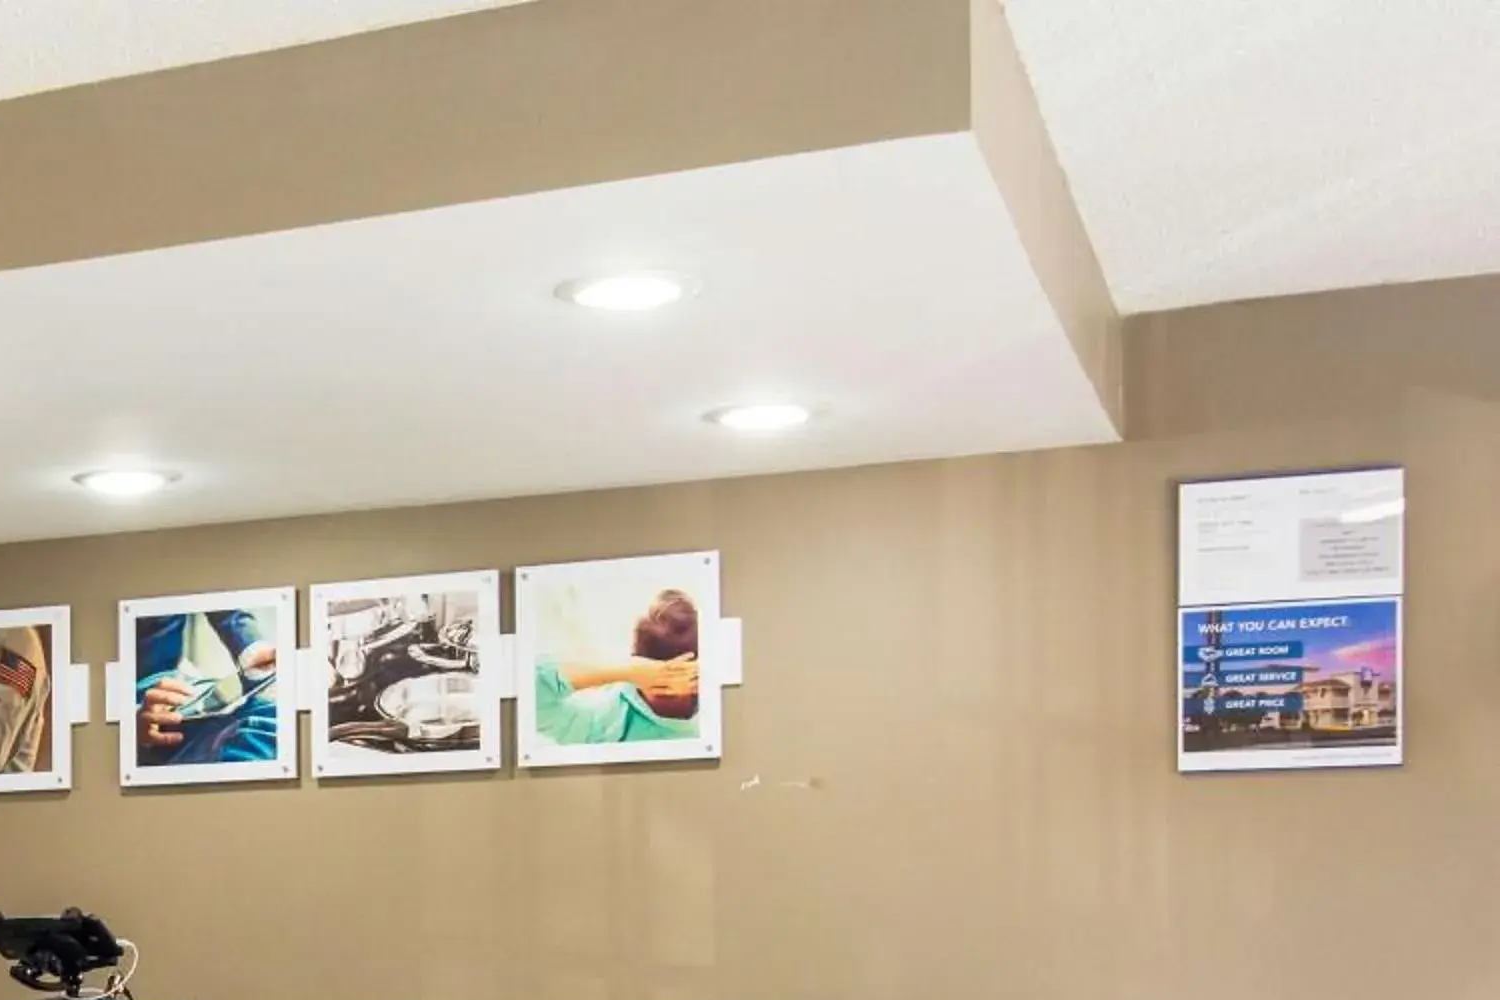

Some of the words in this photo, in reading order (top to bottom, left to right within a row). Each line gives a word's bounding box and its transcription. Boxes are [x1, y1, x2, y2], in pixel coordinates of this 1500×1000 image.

[1197, 622, 1234, 633] WHAT
[1238, 620, 1264, 632] YOU
[1267, 618, 1296, 631] CAN
[1225, 647, 1256, 657] GREAT
[1258, 644, 1289, 655] ROOM
[1225, 673, 1256, 683] GREAT
[1258, 671, 1297, 681] SERVICE
[1225, 699, 1256, 709] GREAT
[1258, 698, 1285, 707] PRICE
